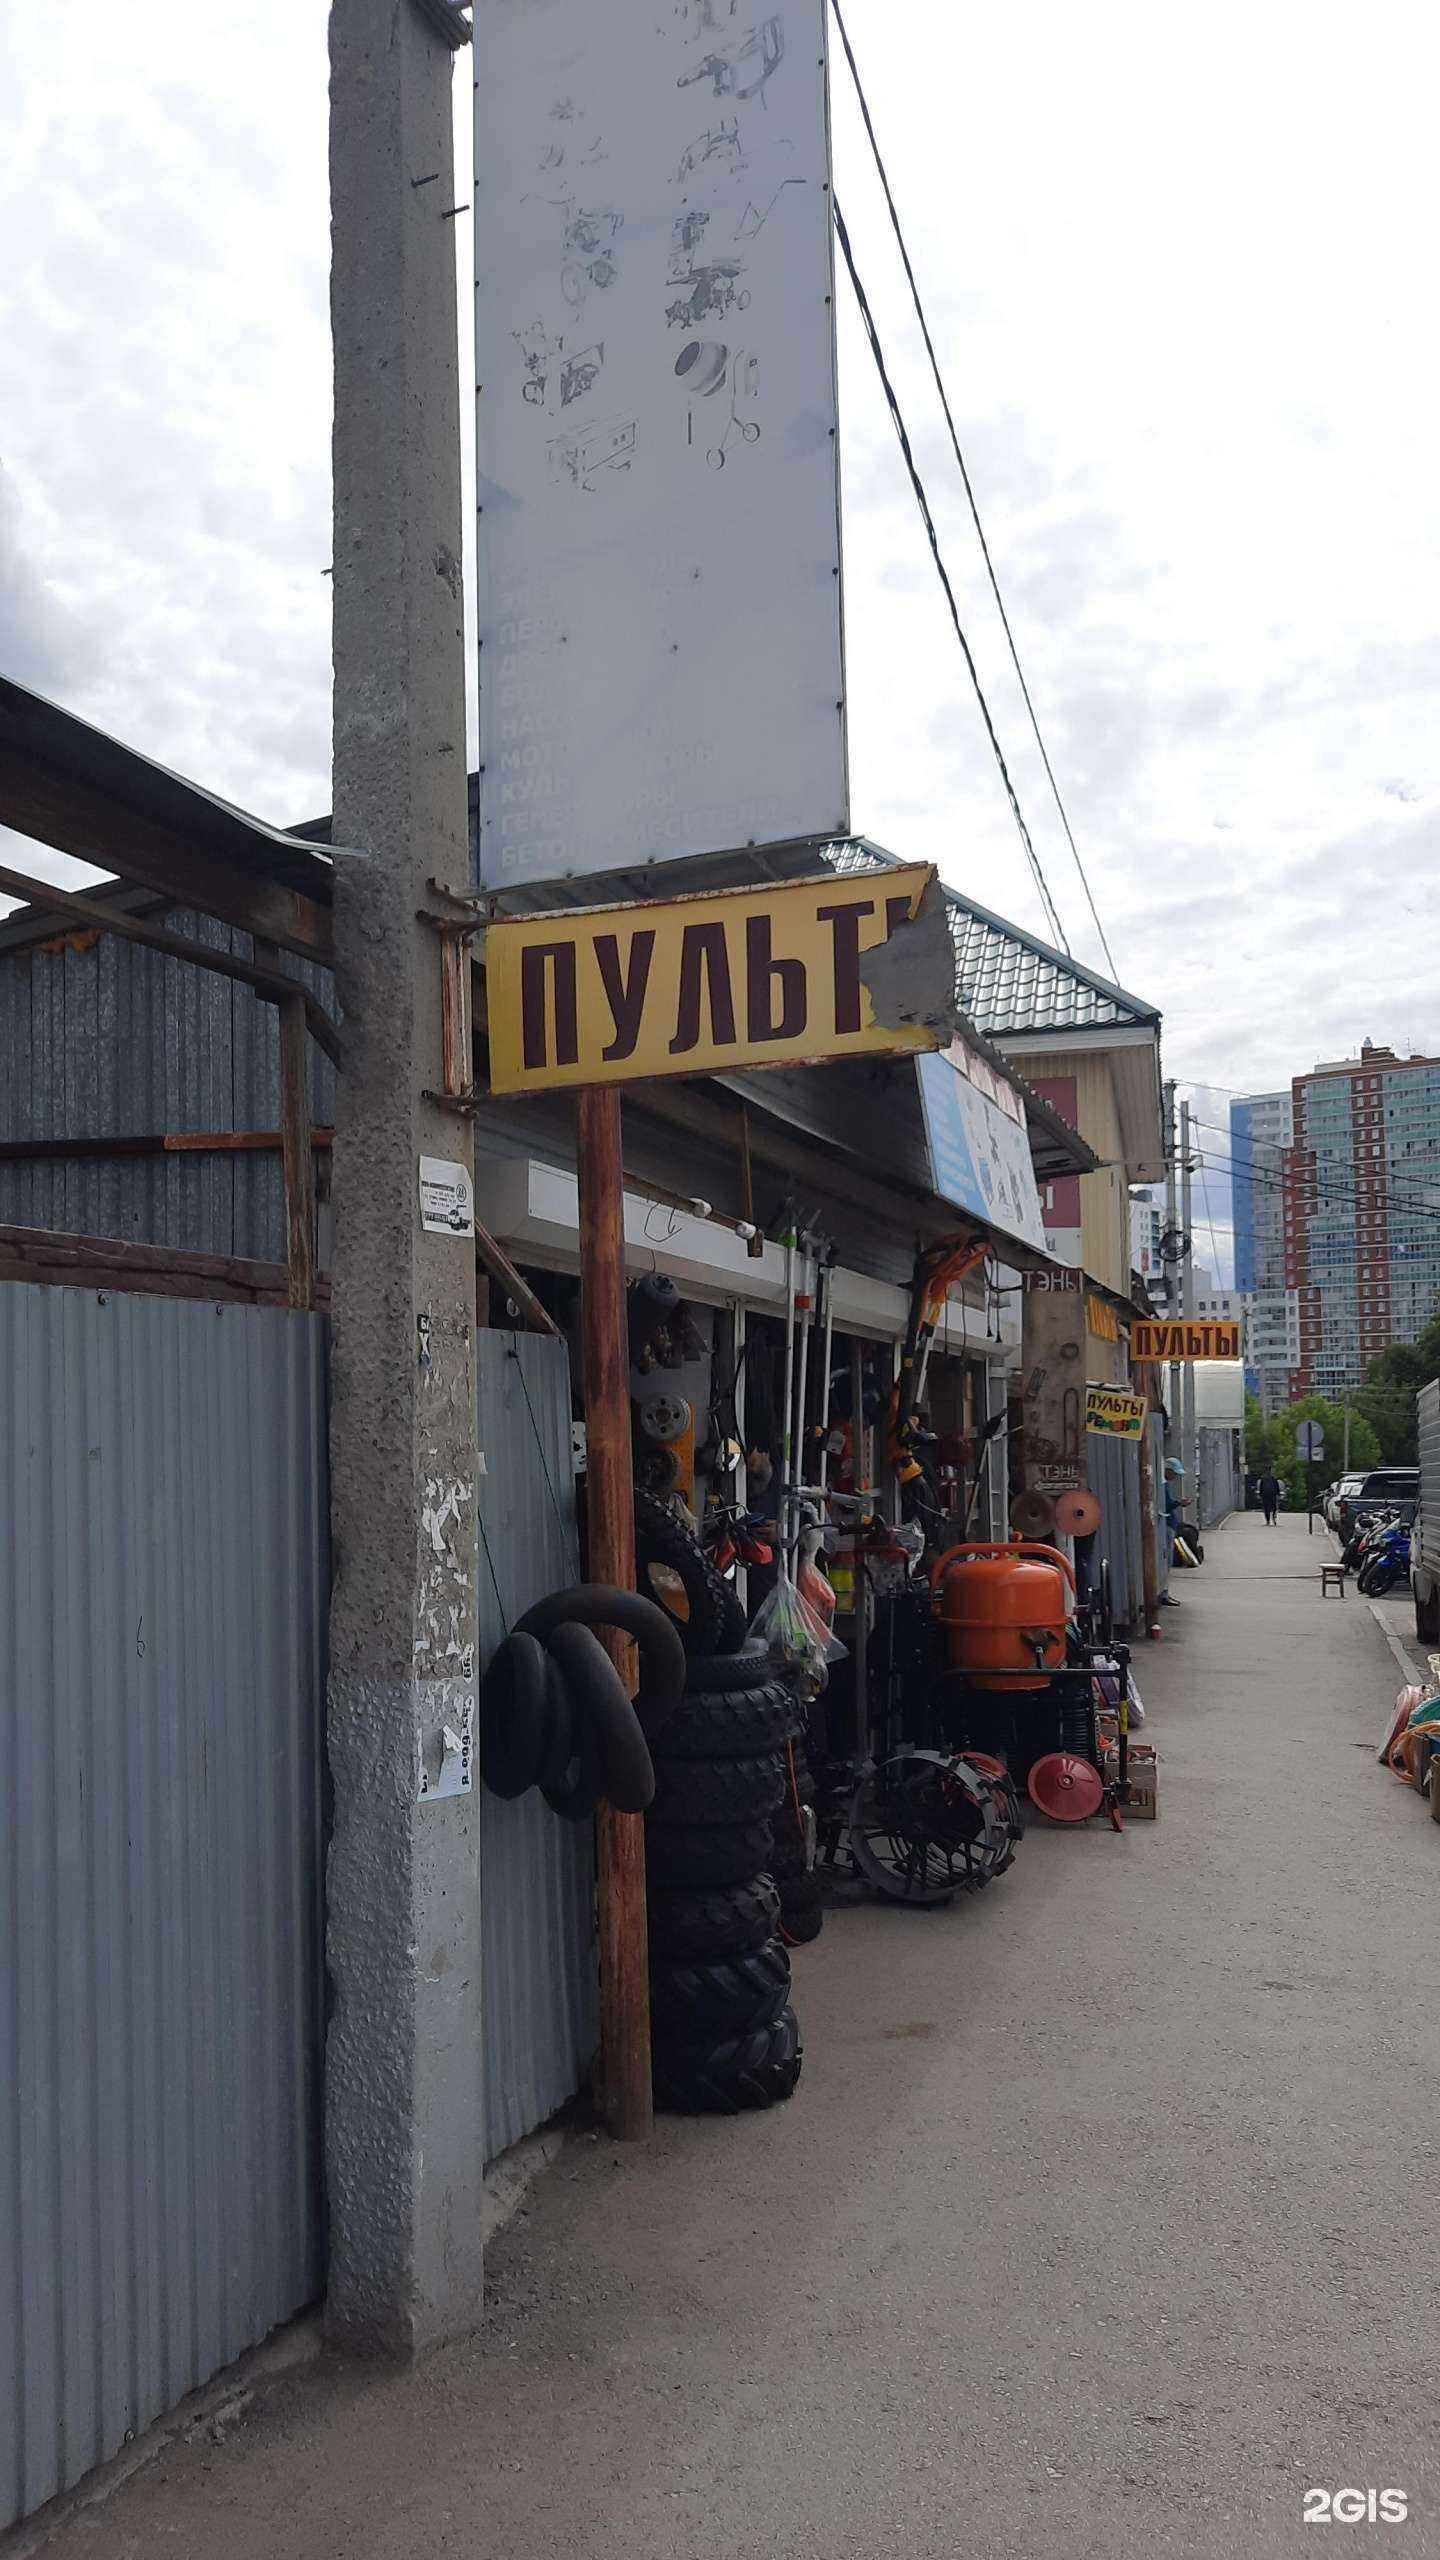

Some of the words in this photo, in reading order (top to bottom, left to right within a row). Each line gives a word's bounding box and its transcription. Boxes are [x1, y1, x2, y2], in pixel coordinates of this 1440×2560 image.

[522, 896, 913, 1070] ПУЛЬТ
[1023, 1269, 1084, 1294] ТЭНЫ
[1136, 1326, 1239, 1356] ПУЛЬТЫ
[1087, 1394, 1143, 1416] ПУЛЬТЫ
